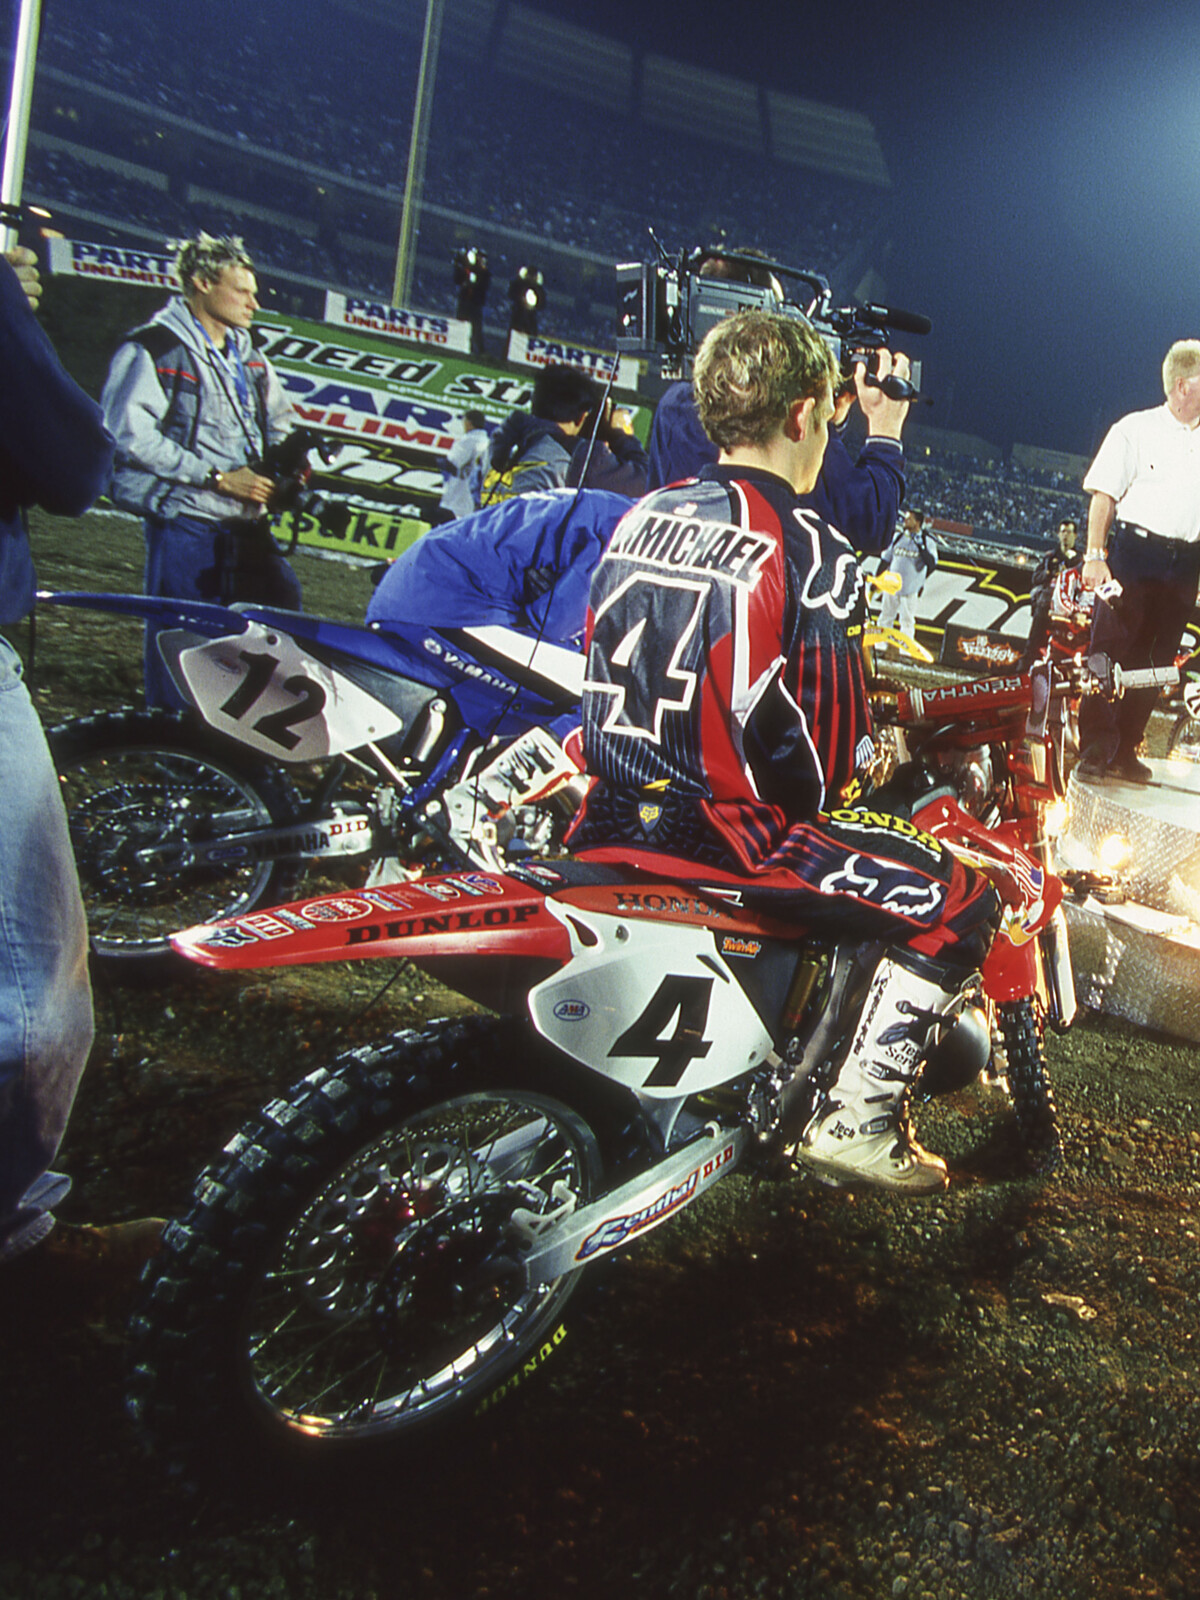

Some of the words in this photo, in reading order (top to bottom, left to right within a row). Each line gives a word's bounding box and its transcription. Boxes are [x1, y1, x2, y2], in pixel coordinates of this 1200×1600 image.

[72, 242, 173, 274] PART
[73, 260, 178, 287] UNLIMIT
[344, 312, 448, 344] UNLIMITED
[346, 298, 448, 333] PARTS
[526, 351, 618, 382] UNTED
[528, 337, 620, 372] PARTS
[448, 374, 533, 407] sti
[444, 651, 517, 695] YAMAHA
[584, 571, 713, 746] 4
[220, 650, 327, 751] 12
[923, 676, 1022, 702] RENTHA
[831, 808, 942, 854] ONDA
[613, 892, 736, 920] HONDA
[344, 903, 540, 946] DUNLOP
[606, 973, 715, 1087] 4
[834, 1120, 856, 1140] Tech
[575, 1168, 700, 1260] Renthal
